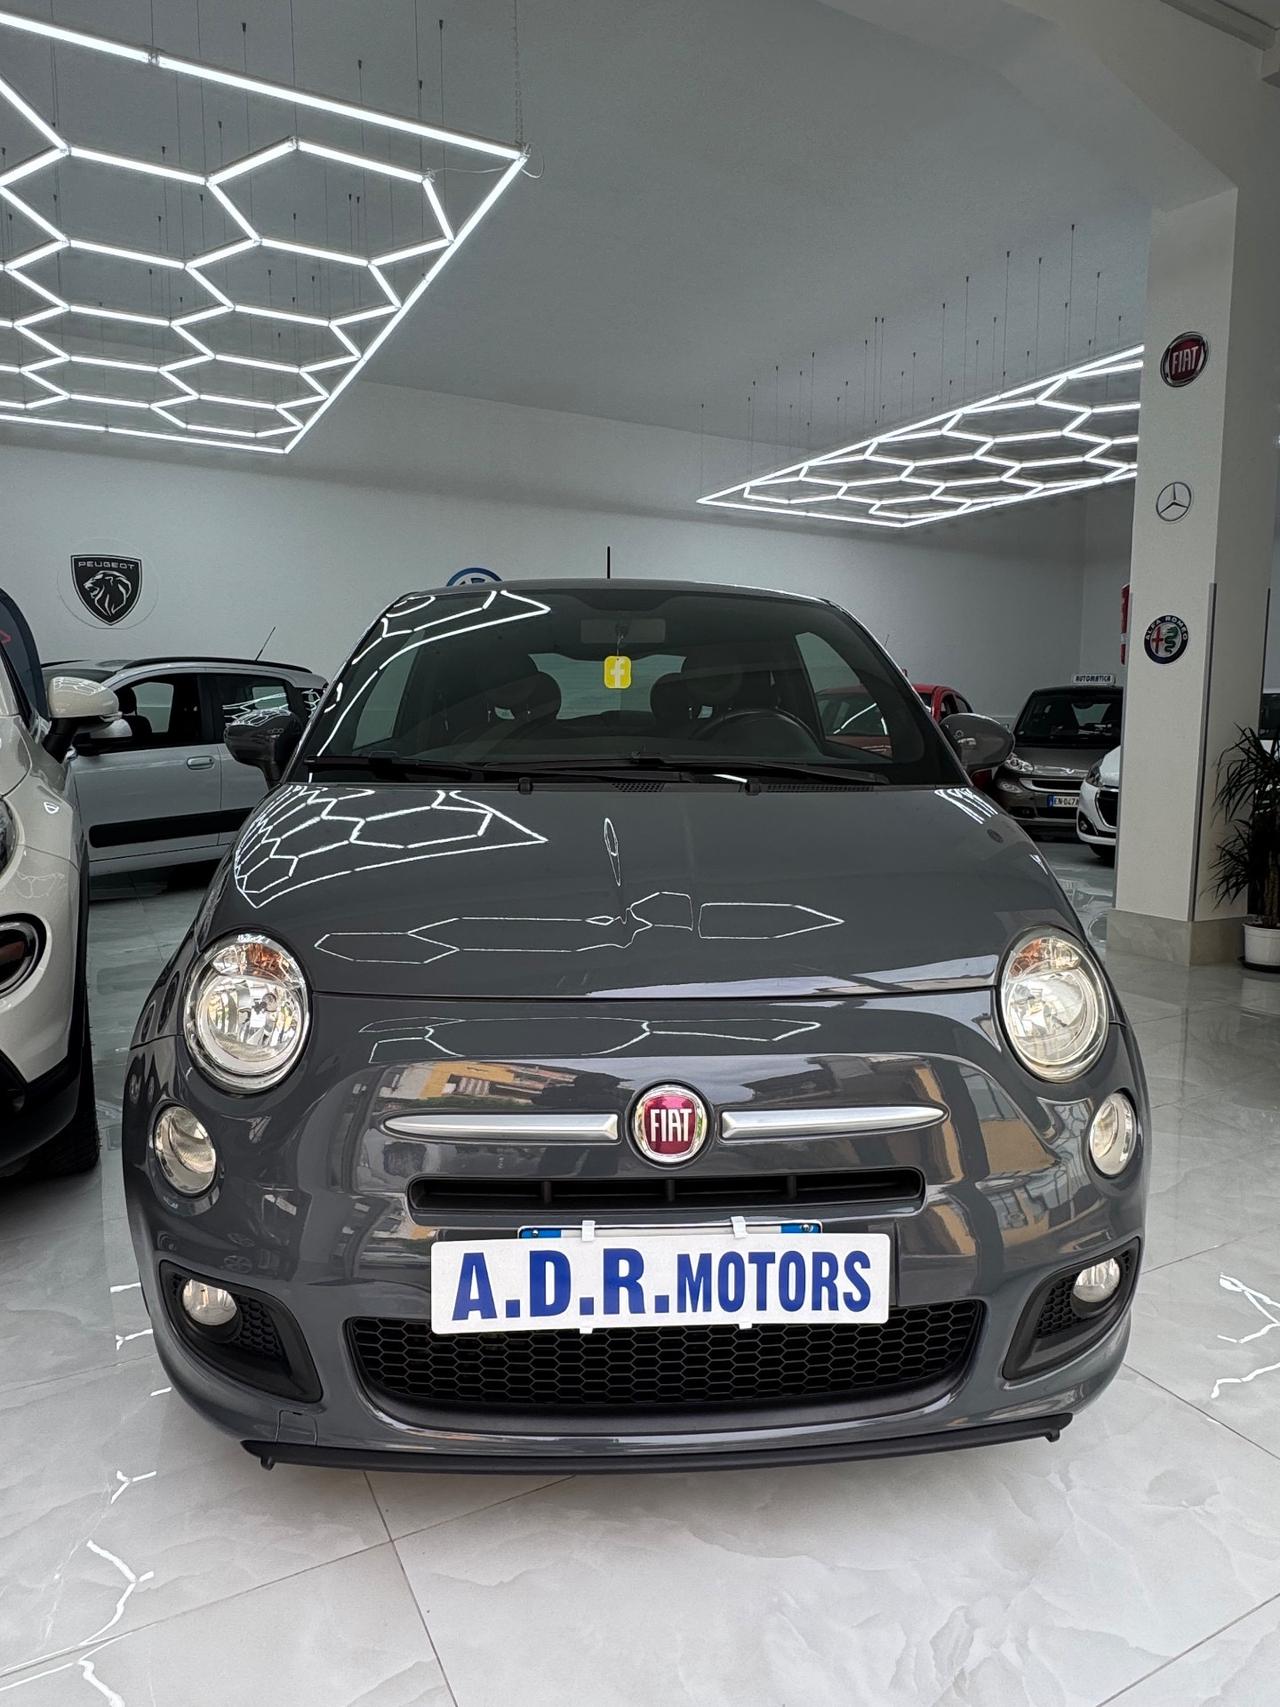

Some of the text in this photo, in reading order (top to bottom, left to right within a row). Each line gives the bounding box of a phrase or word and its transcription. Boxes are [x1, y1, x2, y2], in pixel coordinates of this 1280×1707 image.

[1171, 345, 1199, 375] FIAT
[78, 560, 135, 570] PEUGEOT
[1145, 615, 1188, 641] ALFA ROMEO
[650, 1108, 692, 1142] FIAT
